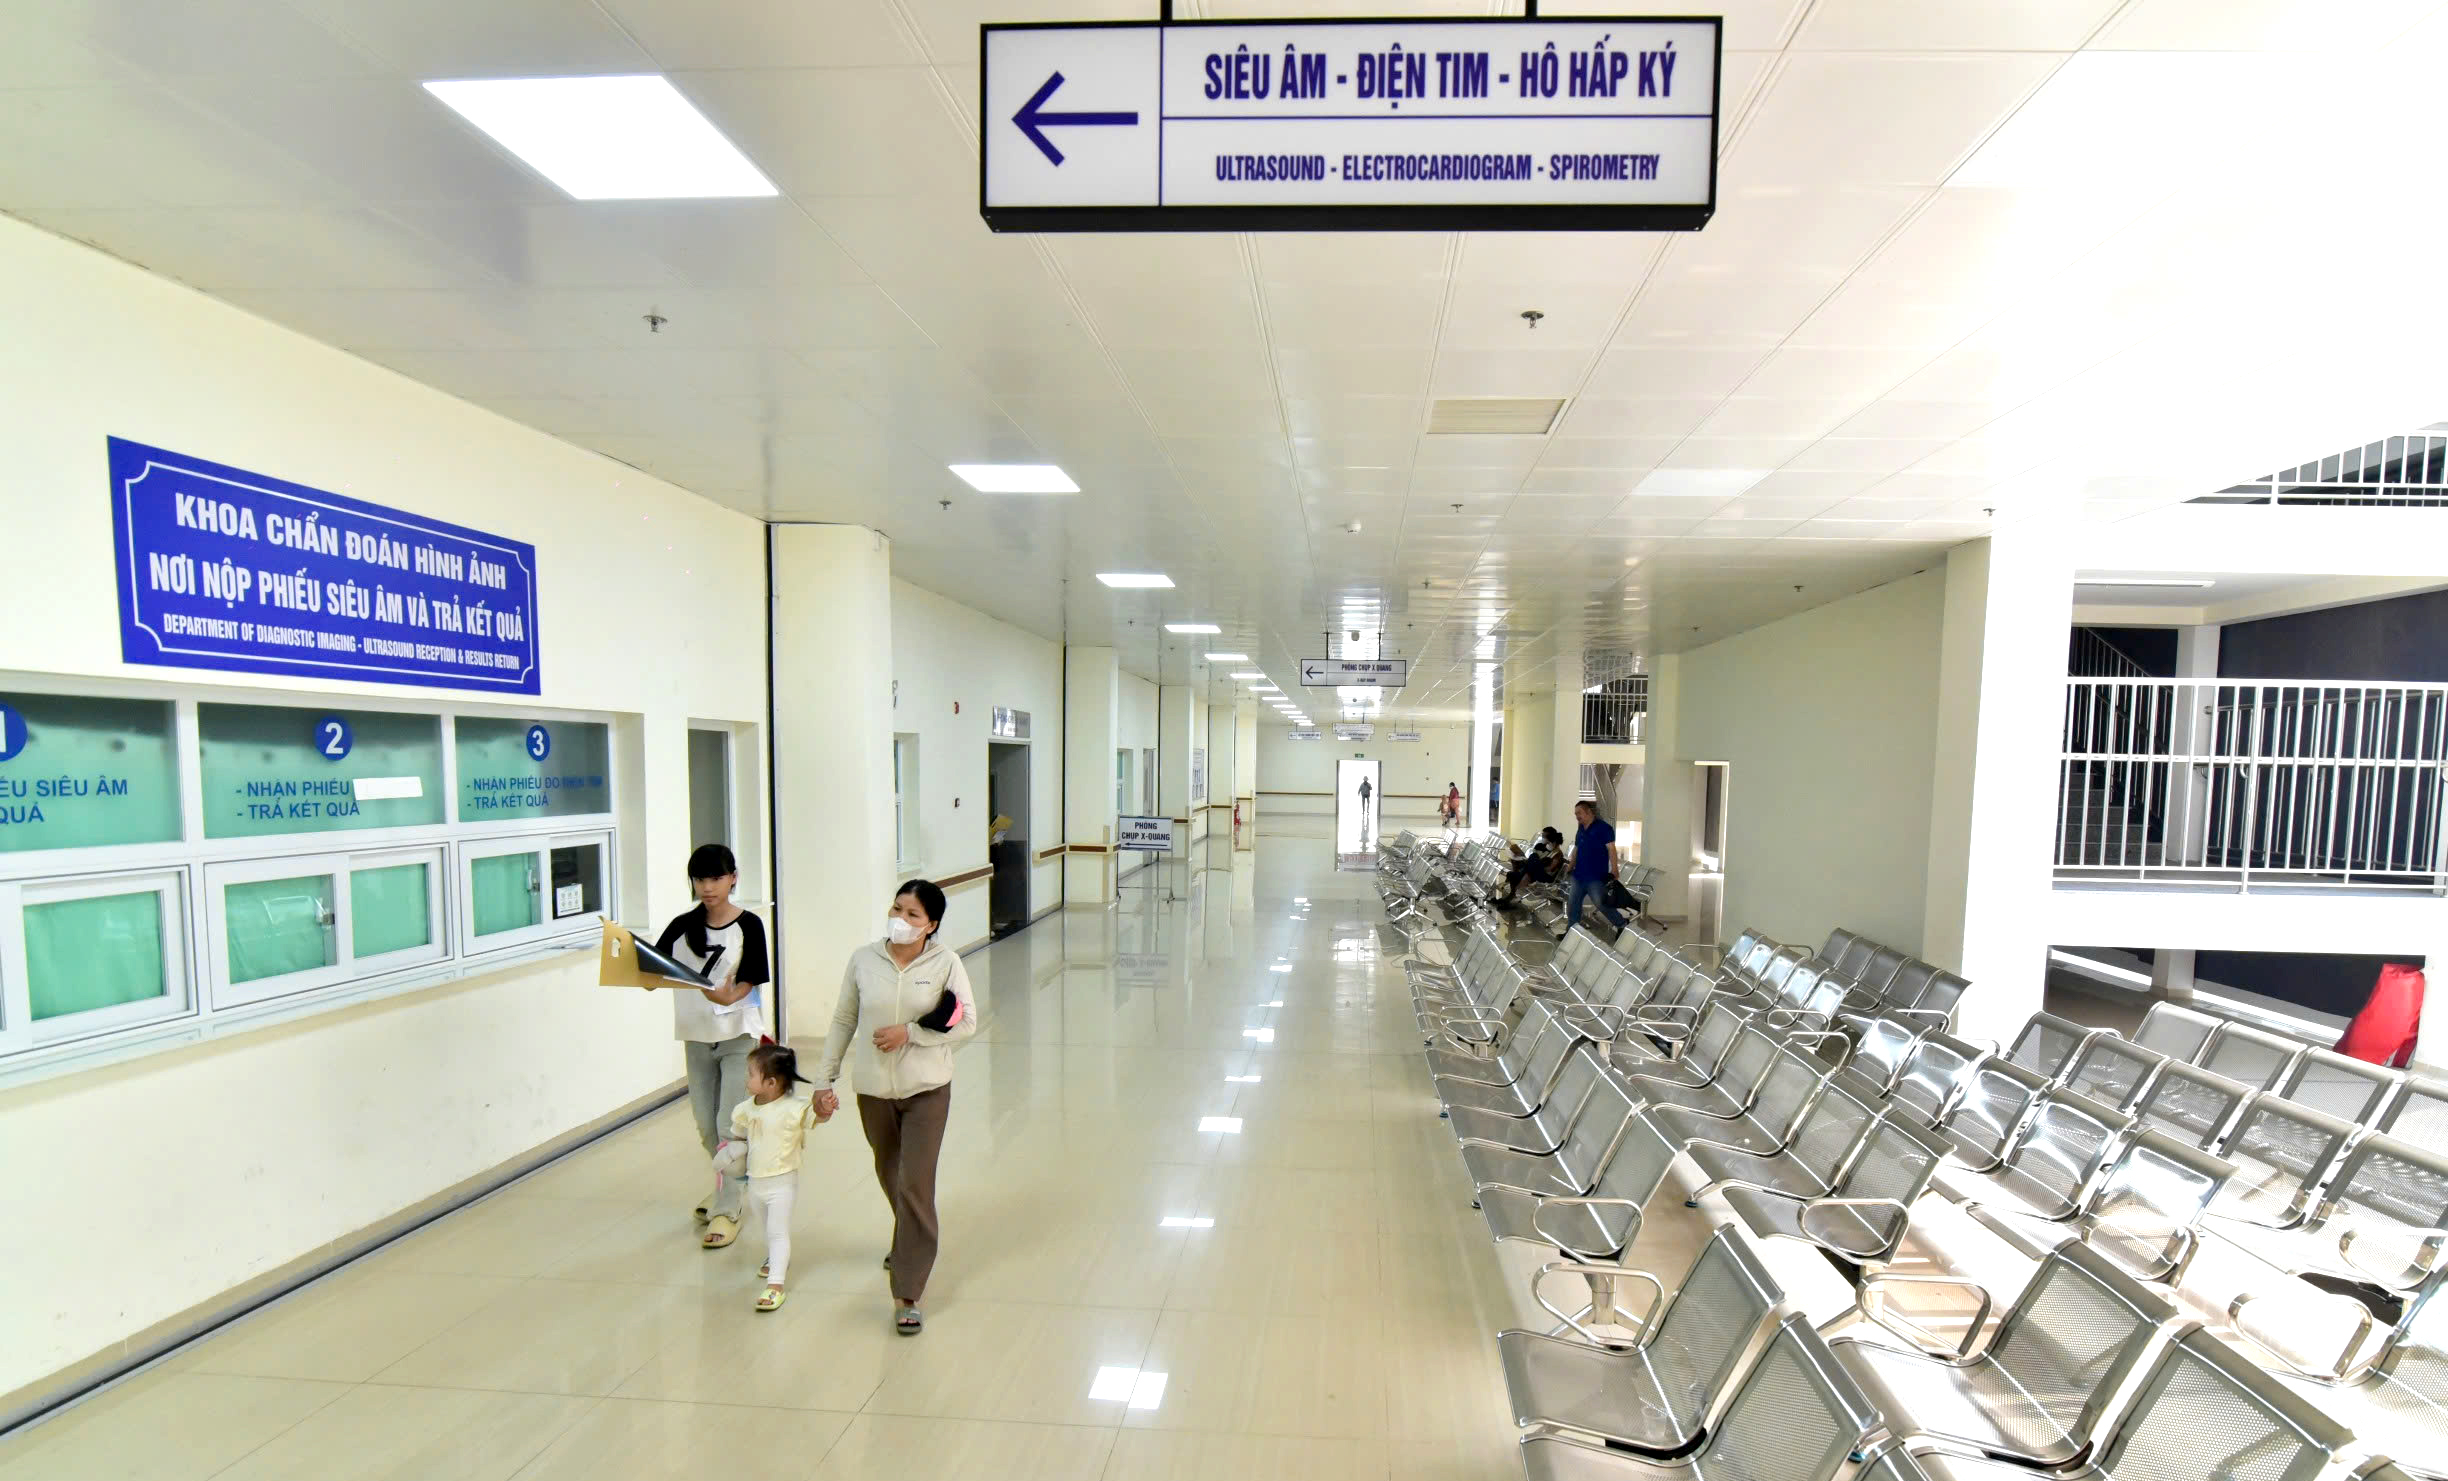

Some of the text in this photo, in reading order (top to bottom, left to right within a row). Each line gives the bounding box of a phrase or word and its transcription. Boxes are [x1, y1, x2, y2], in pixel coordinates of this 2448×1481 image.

[1204, 34, 1677, 109] SIÊU ÂM - ĐIỆN TIM - HÔ HẤP KÝ
[1216, 154, 1325, 181] ULTRASOUND
[1342, 154, 1532, 181] ELECTROCARDIOGRAM
[1549, 153, 1660, 181] SPIROMETRY
[175, 492, 506, 590] KHOA CHẨN ĐOÁN HÌNH ẢNH
[149, 552, 524, 642] NƠI NỘP PHIẾU SIÊU ÂM VÀ TRẢ KẾT QUẢ
[163, 613, 238, 640] DEPARTMENT
[241, 622, 254, 642] OF
[256, 624, 315, 648] DIAGNOSTIC
[317, 631, 356, 652] IMAGING
[363, 637, 415, 659] ULTRASOUND
[416, 643, 457, 663] RECEPTION
[458, 649, 463, 664] &
[464, 650, 493, 667] RESULTS
[494, 653, 520, 670] RETURN
[325, 722, 344, 754] 2
[532, 730, 545, 756] 3
[36, 775, 88, 797] SIÊU
[96, 774, 128, 796] ÂM
[248, 797, 284, 819] TRẢ
[1140, 832, 1170, 841] X-QUANG
[699, 944, 726, 978] 7
